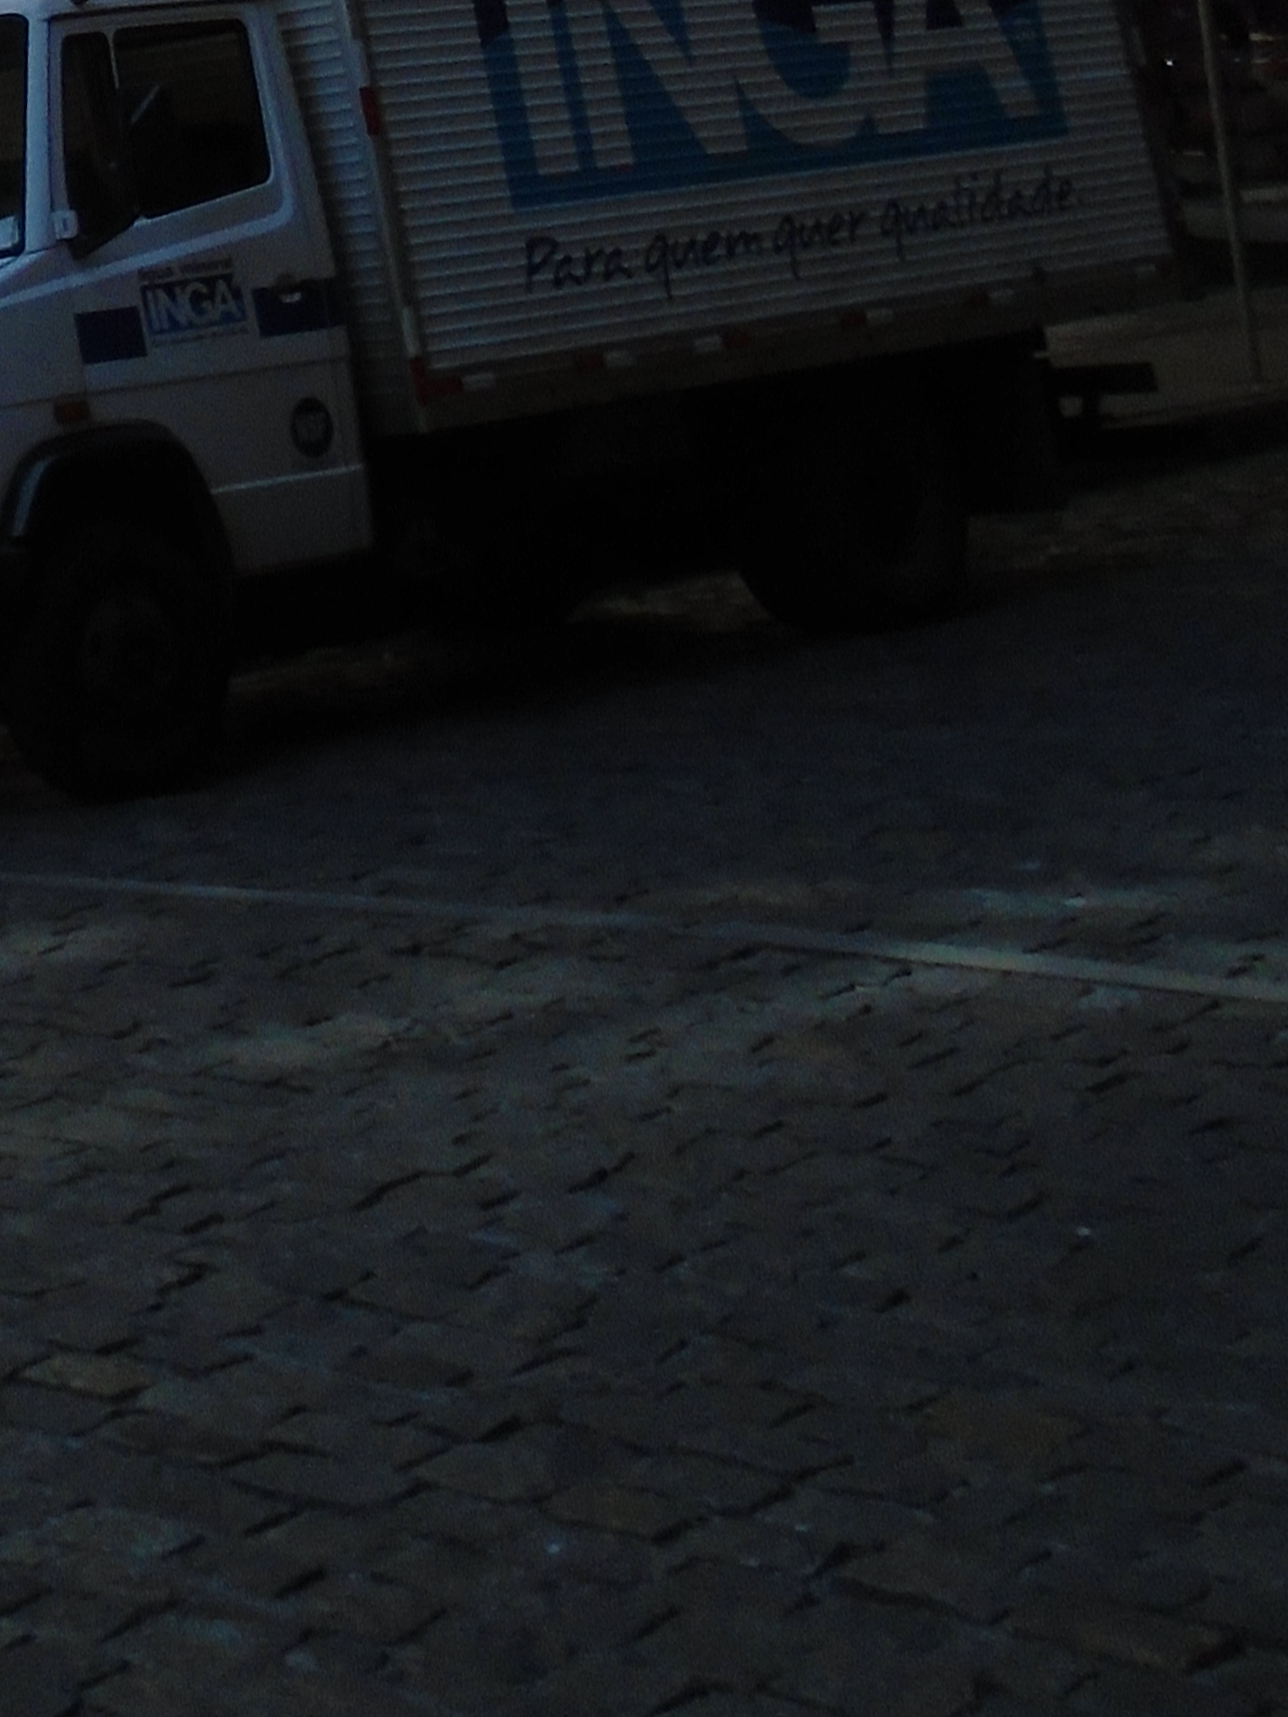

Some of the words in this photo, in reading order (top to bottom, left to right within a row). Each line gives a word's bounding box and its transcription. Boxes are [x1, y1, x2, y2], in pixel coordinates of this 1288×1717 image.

[525, 235, 633, 293] Para
[644, 227, 768, 301] quem
[772, 207, 868, 282] quer
